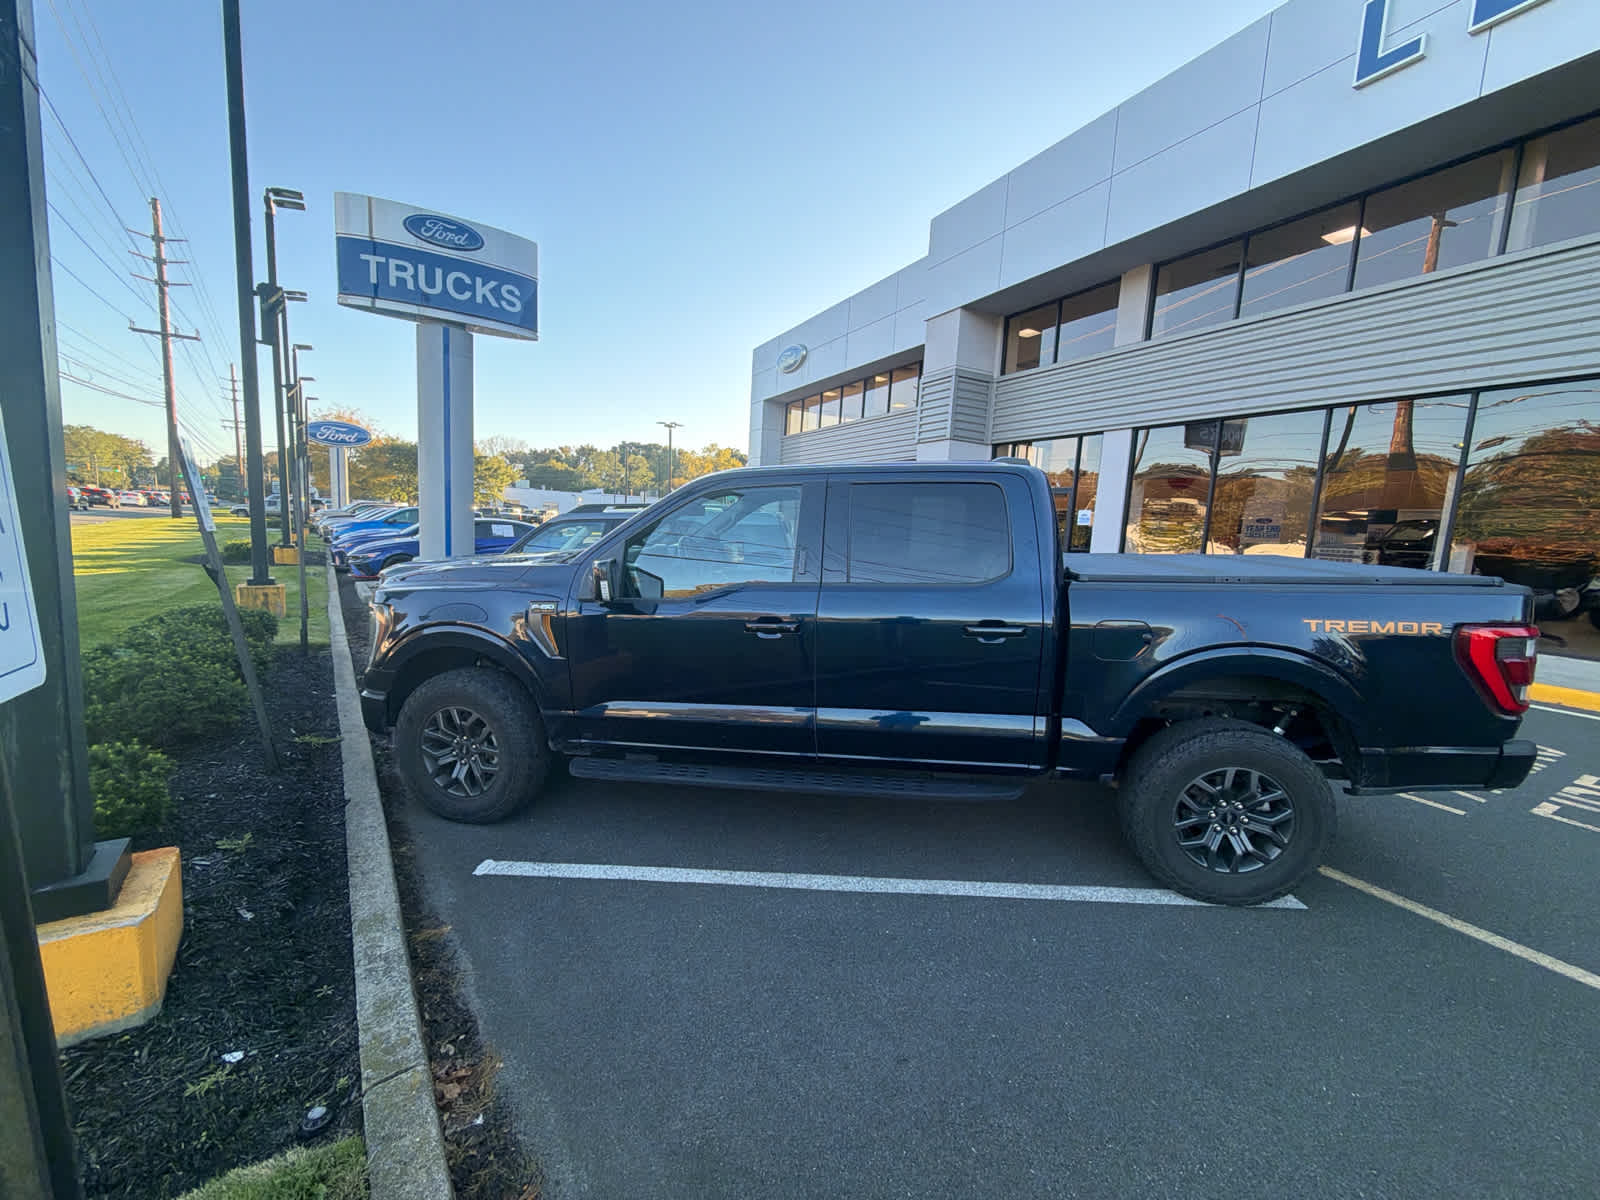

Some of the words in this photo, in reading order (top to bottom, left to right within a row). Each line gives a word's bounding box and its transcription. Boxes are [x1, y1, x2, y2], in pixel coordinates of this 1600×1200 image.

[420, 219, 469, 246] Ford
[359, 253, 522, 313] TRUCKS
[316, 425, 359, 442] Ford
[1303, 619, 1444, 635] TREMOR
